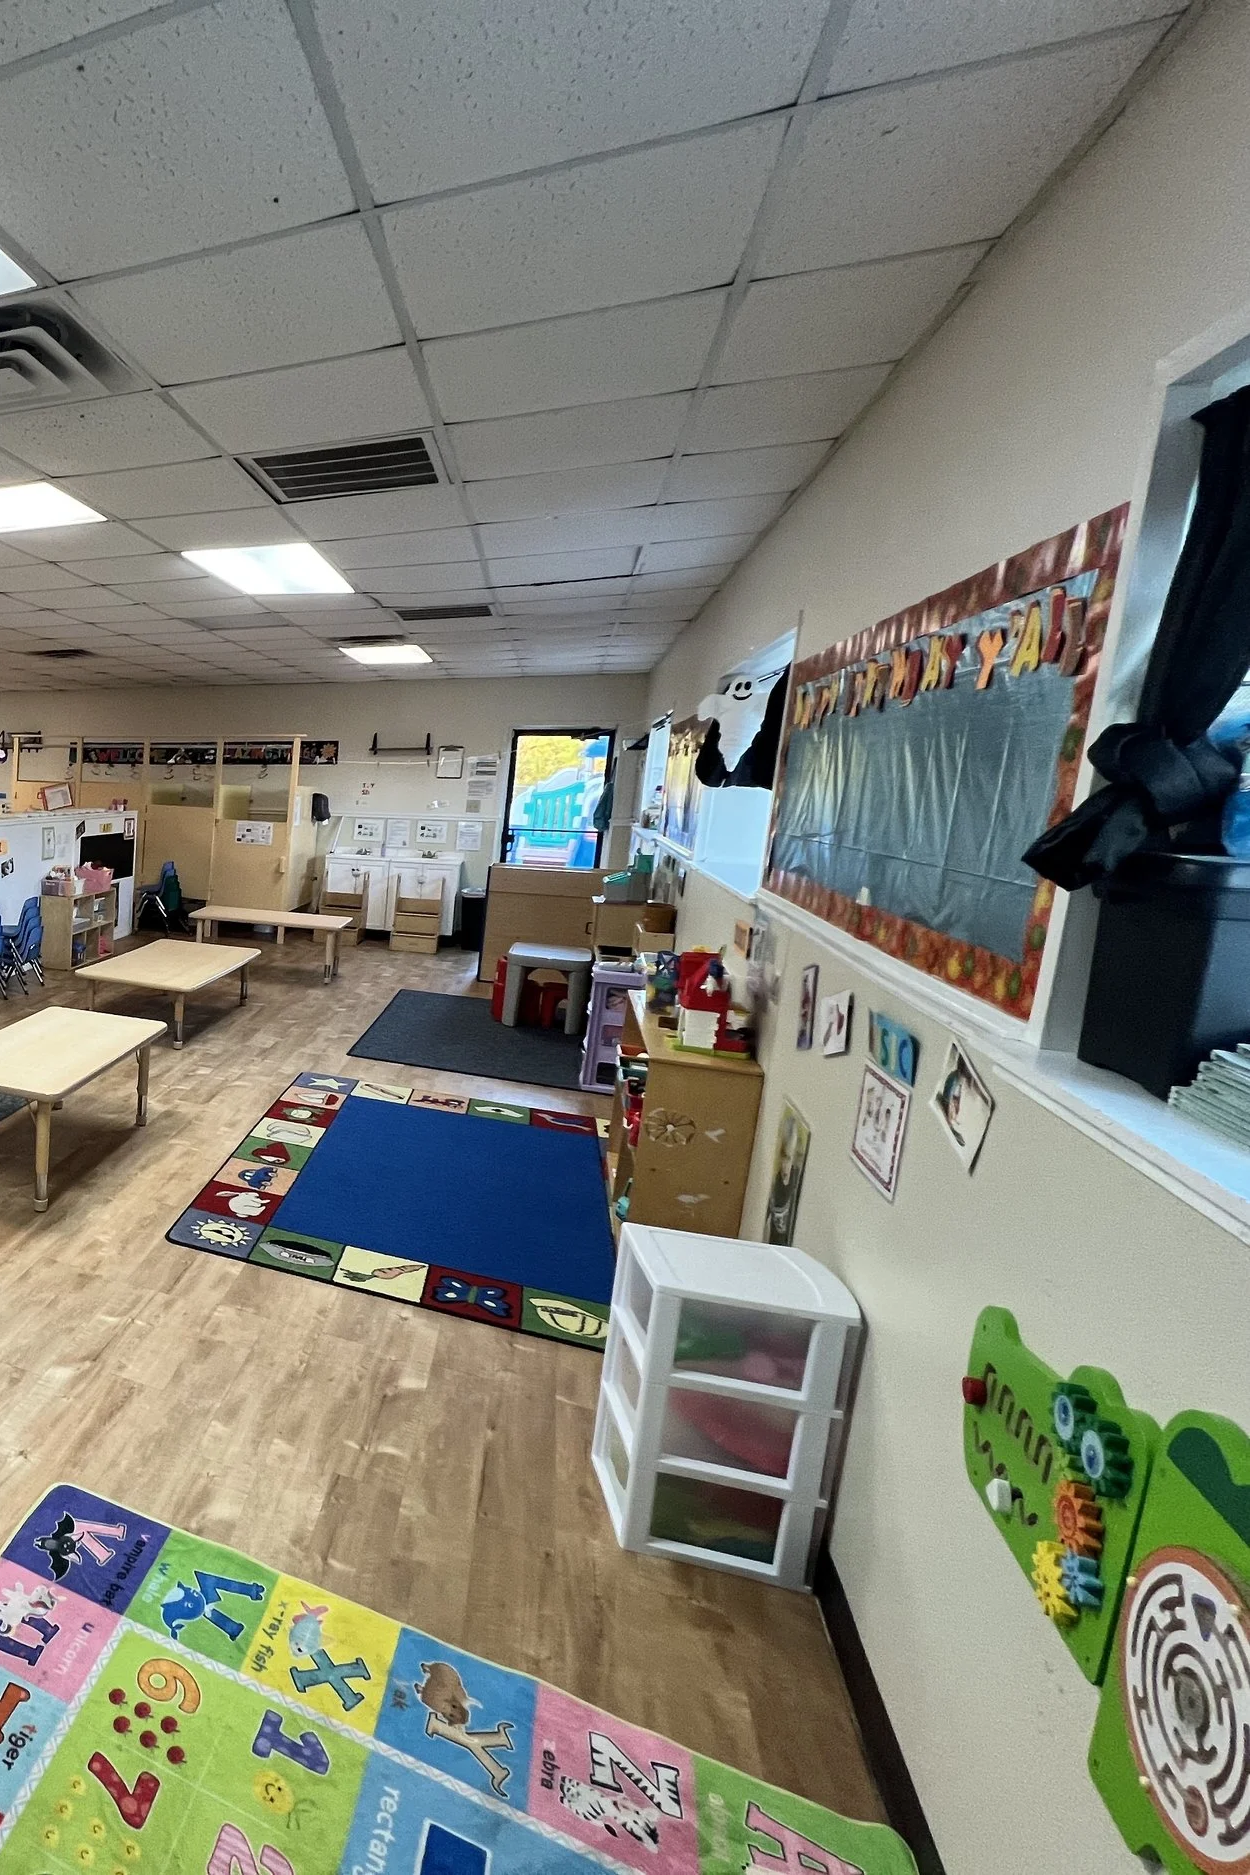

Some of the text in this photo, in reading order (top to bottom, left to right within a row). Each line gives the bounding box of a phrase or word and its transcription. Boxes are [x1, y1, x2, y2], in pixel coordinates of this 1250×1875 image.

[117, 1533, 152, 1581] vampire
[52, 1621, 95, 1676] unicorn
[250, 1600, 289, 1673] x-ray fish
[289, 1649, 372, 1712] X
[1, 1723, 38, 1772] tiger
[252, 1709, 330, 1775] 1
[426, 1711, 516, 1798] Y
[540, 1738, 561, 1791] zebra
[87, 1751, 161, 1829] 7
[588, 1731, 684, 1820] Z
